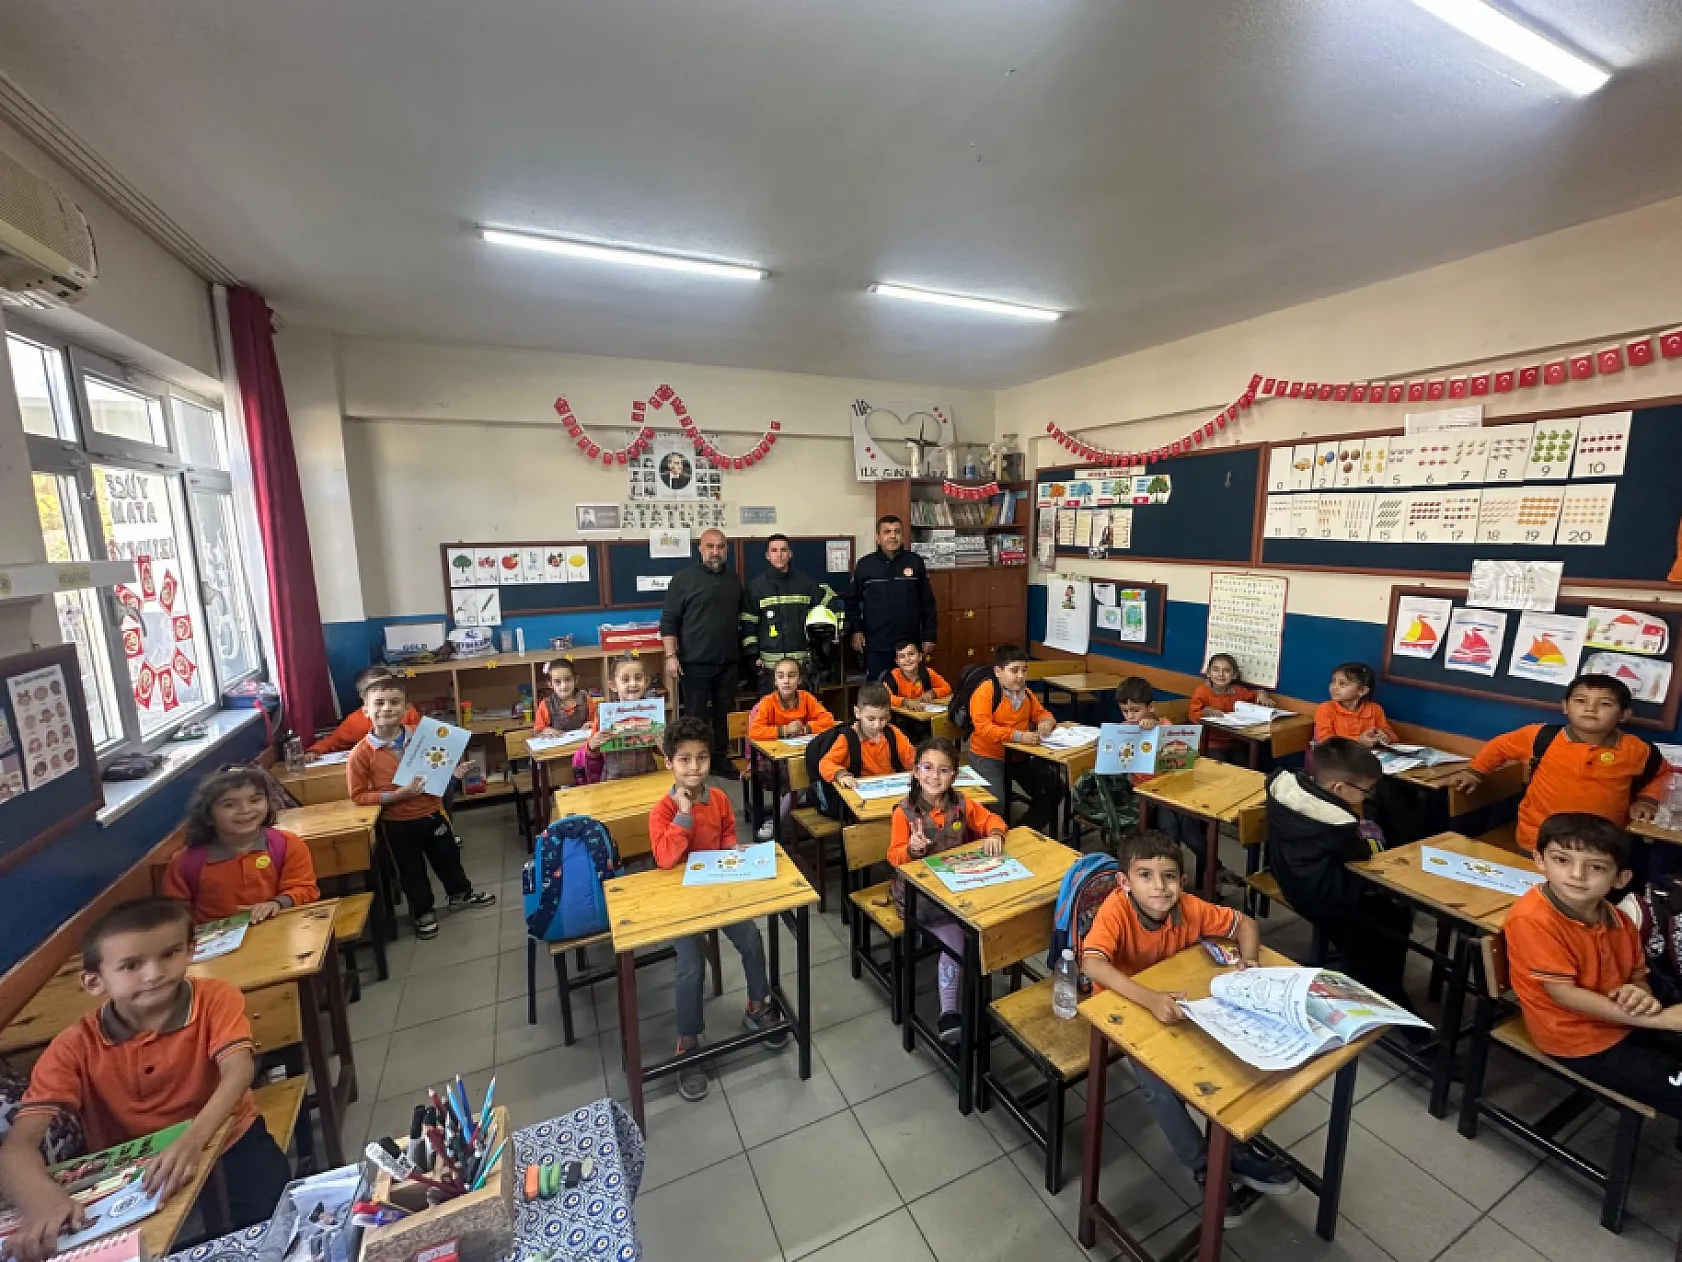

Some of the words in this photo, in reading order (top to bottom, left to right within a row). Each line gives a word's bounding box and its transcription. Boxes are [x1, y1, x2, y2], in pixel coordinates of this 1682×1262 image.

[1498, 468, 1508, 479] 8
[1541, 465, 1552, 477] 9
[1587, 461, 1606, 475] 10
[1366, 475, 1375, 485] 4
[1392, 474, 1401, 485] 5
[1426, 473, 1434, 484] 6
[1460, 470, 1470, 481] 7
[1318, 477, 1327, 488] 2
[1342, 476, 1350, 487] 3
[1274, 527, 1282, 536] 11
[1297, 527, 1307, 537] 12
[1320, 529, 1332, 538] 13
[1348, 530, 1359, 540] 14
[1379, 530, 1392, 541] 15
[1416, 530, 1429, 541] 16
[1450, 530, 1464, 541] 17
[1486, 529, 1501, 541] 18
[1524, 530, 1541, 542] 19
[1567, 530, 1593, 543] 20
